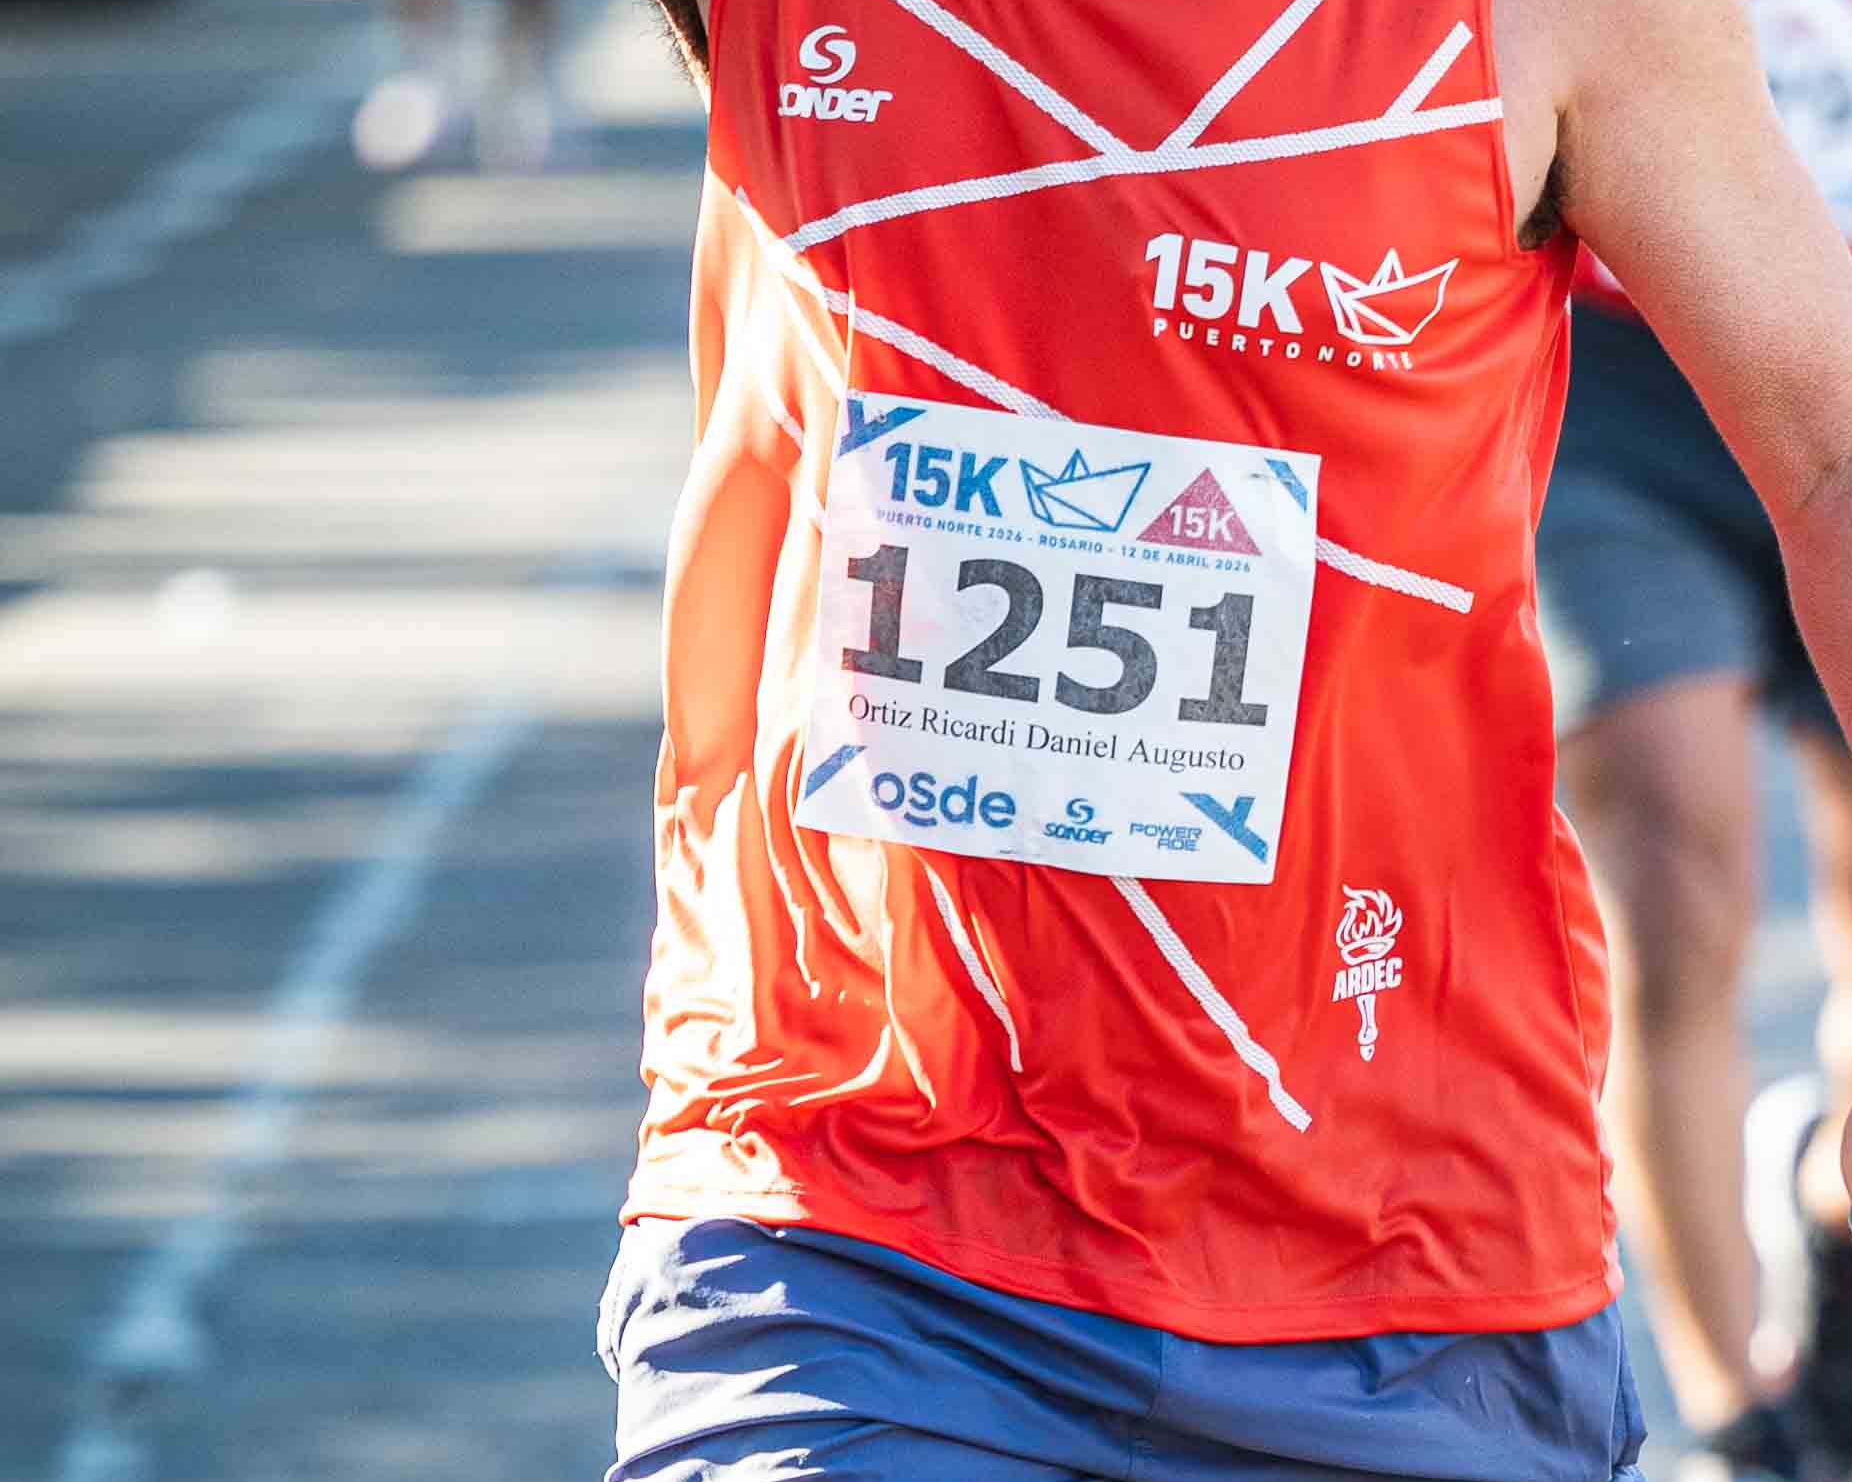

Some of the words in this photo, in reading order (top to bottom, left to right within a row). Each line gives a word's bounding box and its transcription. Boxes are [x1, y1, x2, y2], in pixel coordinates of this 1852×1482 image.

[1145, 232, 1313, 334] 15K
[1152, 317, 1300, 359] PUERTO
[884, 441, 1009, 519] 15K
[877, 508, 933, 529] PUERTO
[936, 518, 983, 536] NORTE
[988, 527, 1022, 543] 2026
[1038, 534, 1103, 554] ROSARIO
[1121, 545, 1137, 559] 12
[1142, 549, 1161, 563] DE
[1166, 552, 1209, 569] ABRIL
[1215, 558, 1251, 574] 2026
[1169, 504, 1236, 542] 15K
[841, 542, 1269, 727] 1251
[848, 693, 912, 729] Ortiz
[920, 707, 1016, 746] Ricardi
[1026, 724, 1118, 760] Daniel
[1127, 740, 1245, 773] Augusto
[872, 770, 1017, 828] osde
[1129, 821, 1203, 840] POWER
[1331, 957, 1403, 1002] ARDEC
